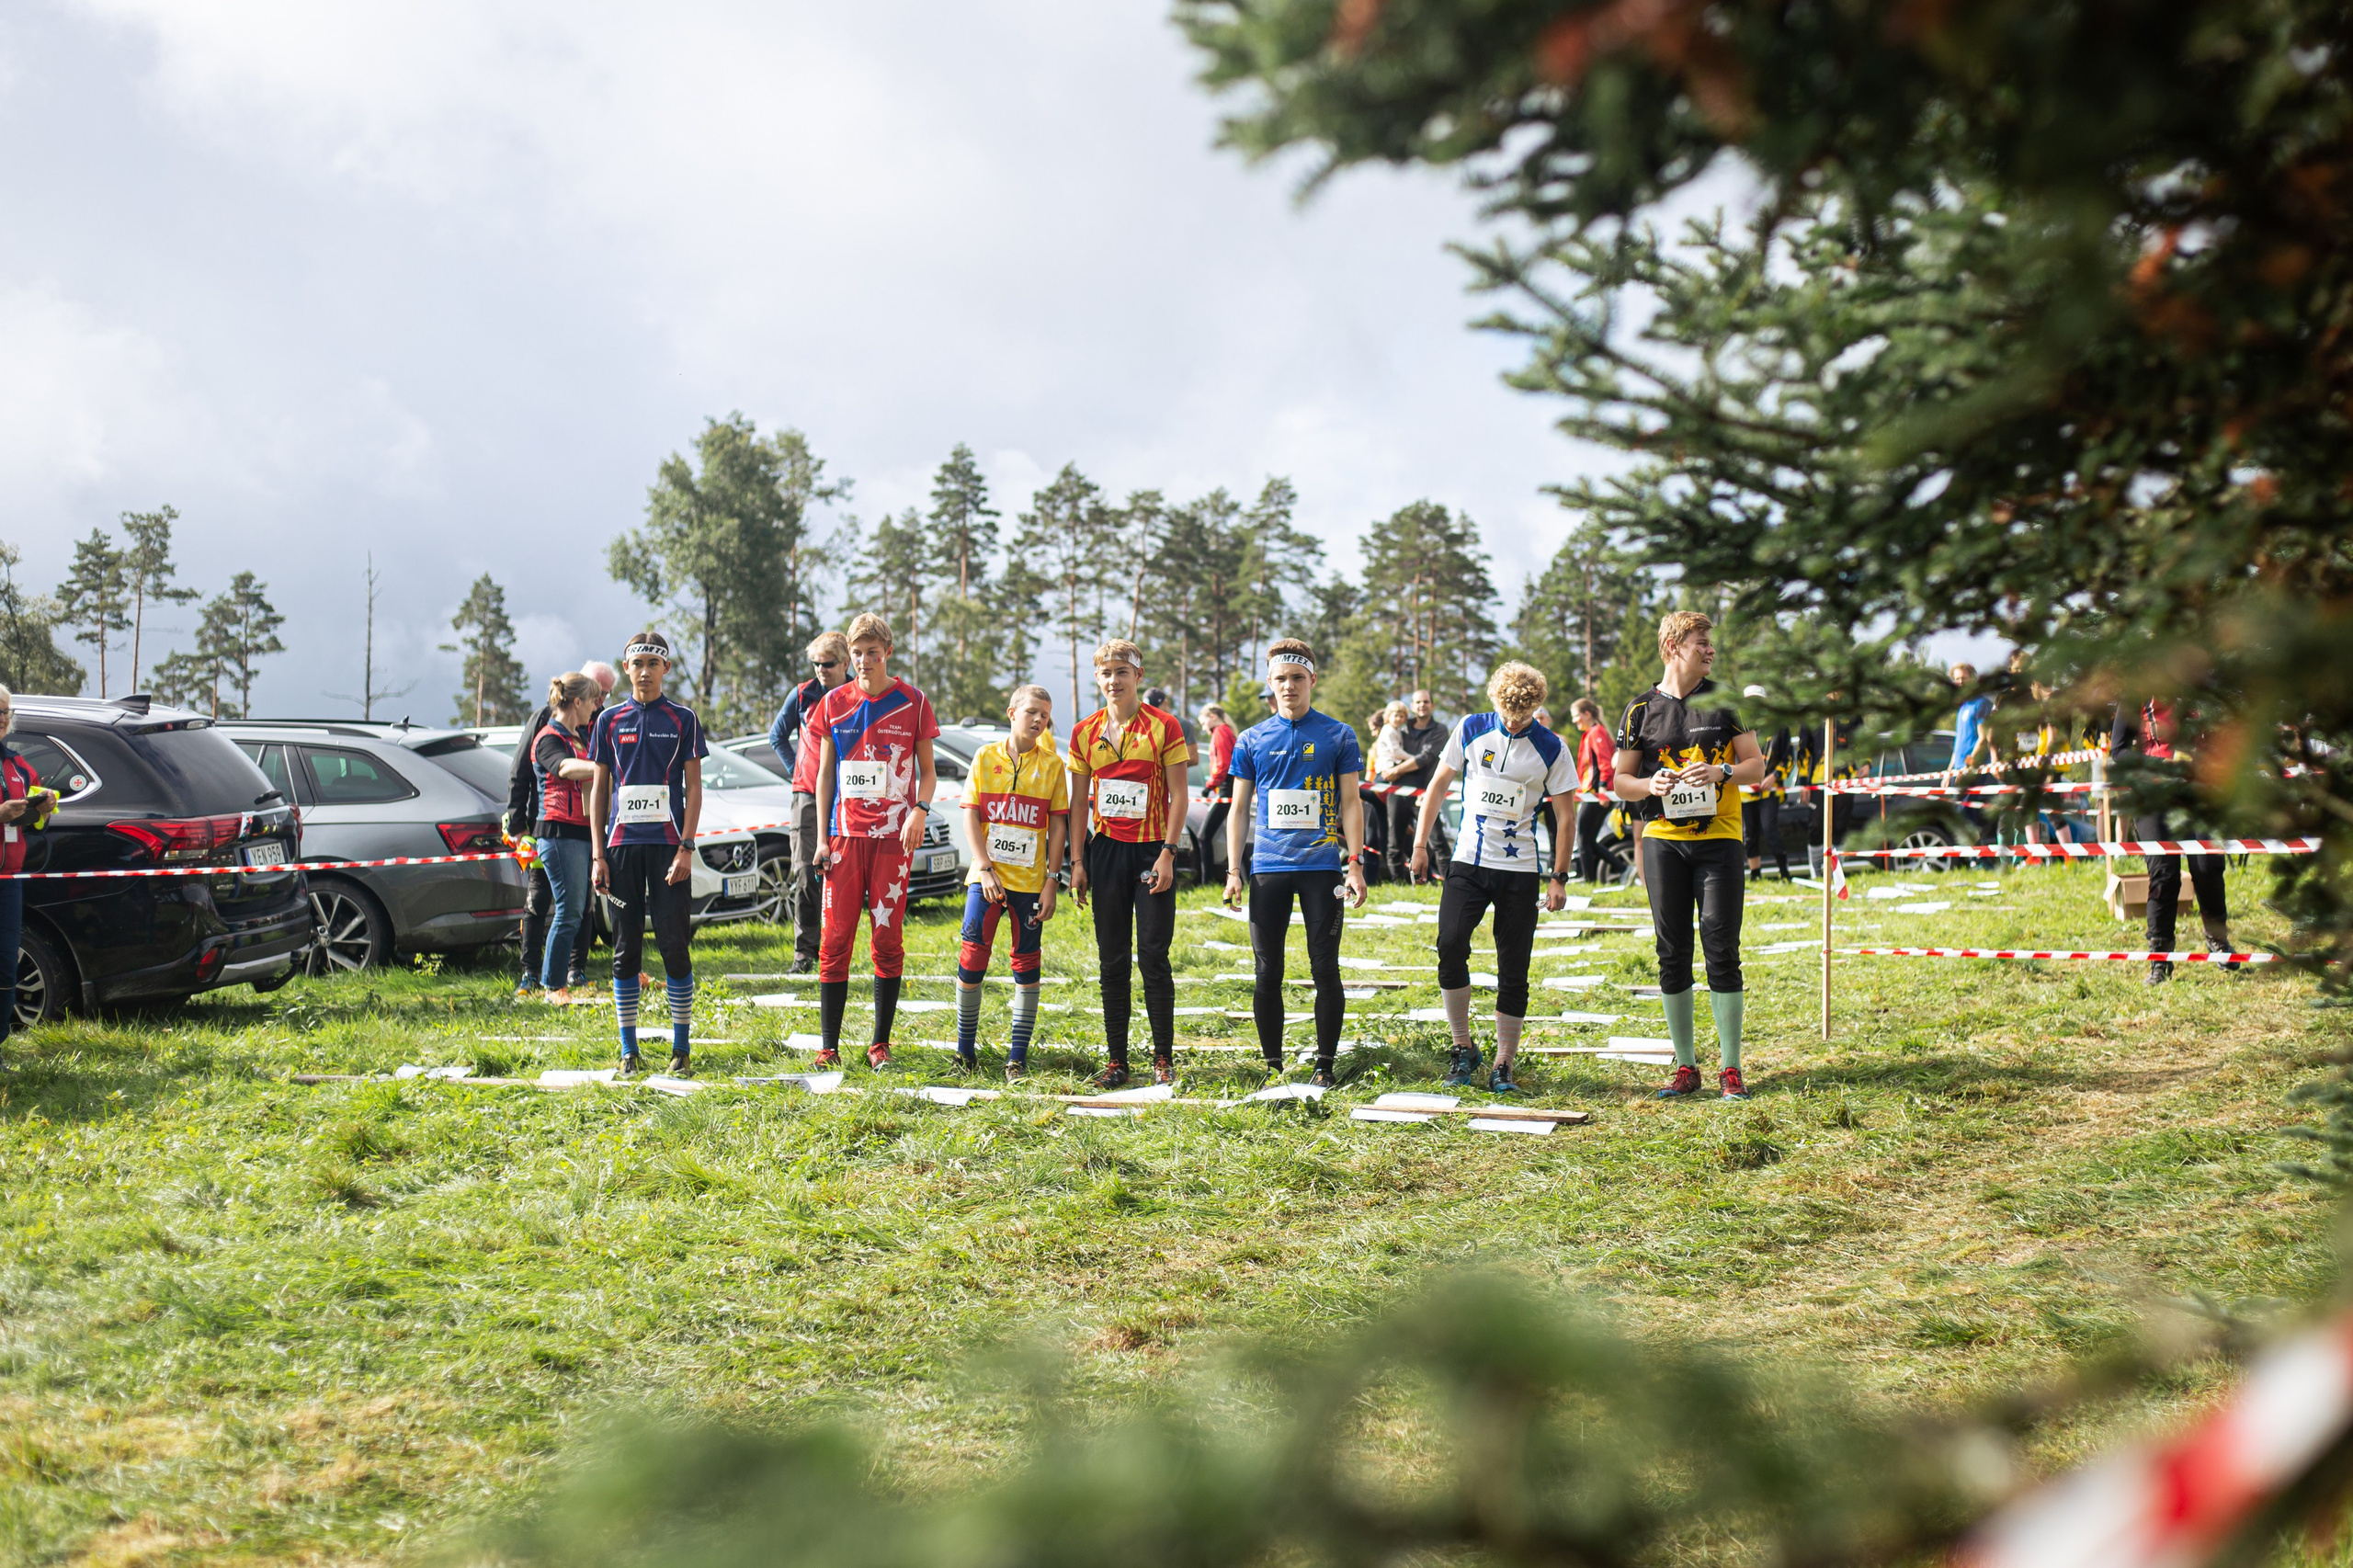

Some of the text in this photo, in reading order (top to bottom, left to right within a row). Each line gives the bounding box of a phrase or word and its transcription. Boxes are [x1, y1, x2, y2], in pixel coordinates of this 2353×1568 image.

[628, 645, 667, 657] TRIMTE
[846, 775, 876, 786] 206-1
[1105, 793, 1136, 806] 204-1
[1481, 790, 1515, 808] 202-1
[1671, 790, 1706, 805] 201-1
[627, 799, 660, 811] 207-1
[986, 796, 1040, 824] SKÅNE
[1276, 803, 1310, 815] 203-1
[994, 838, 1027, 854] 205-1
